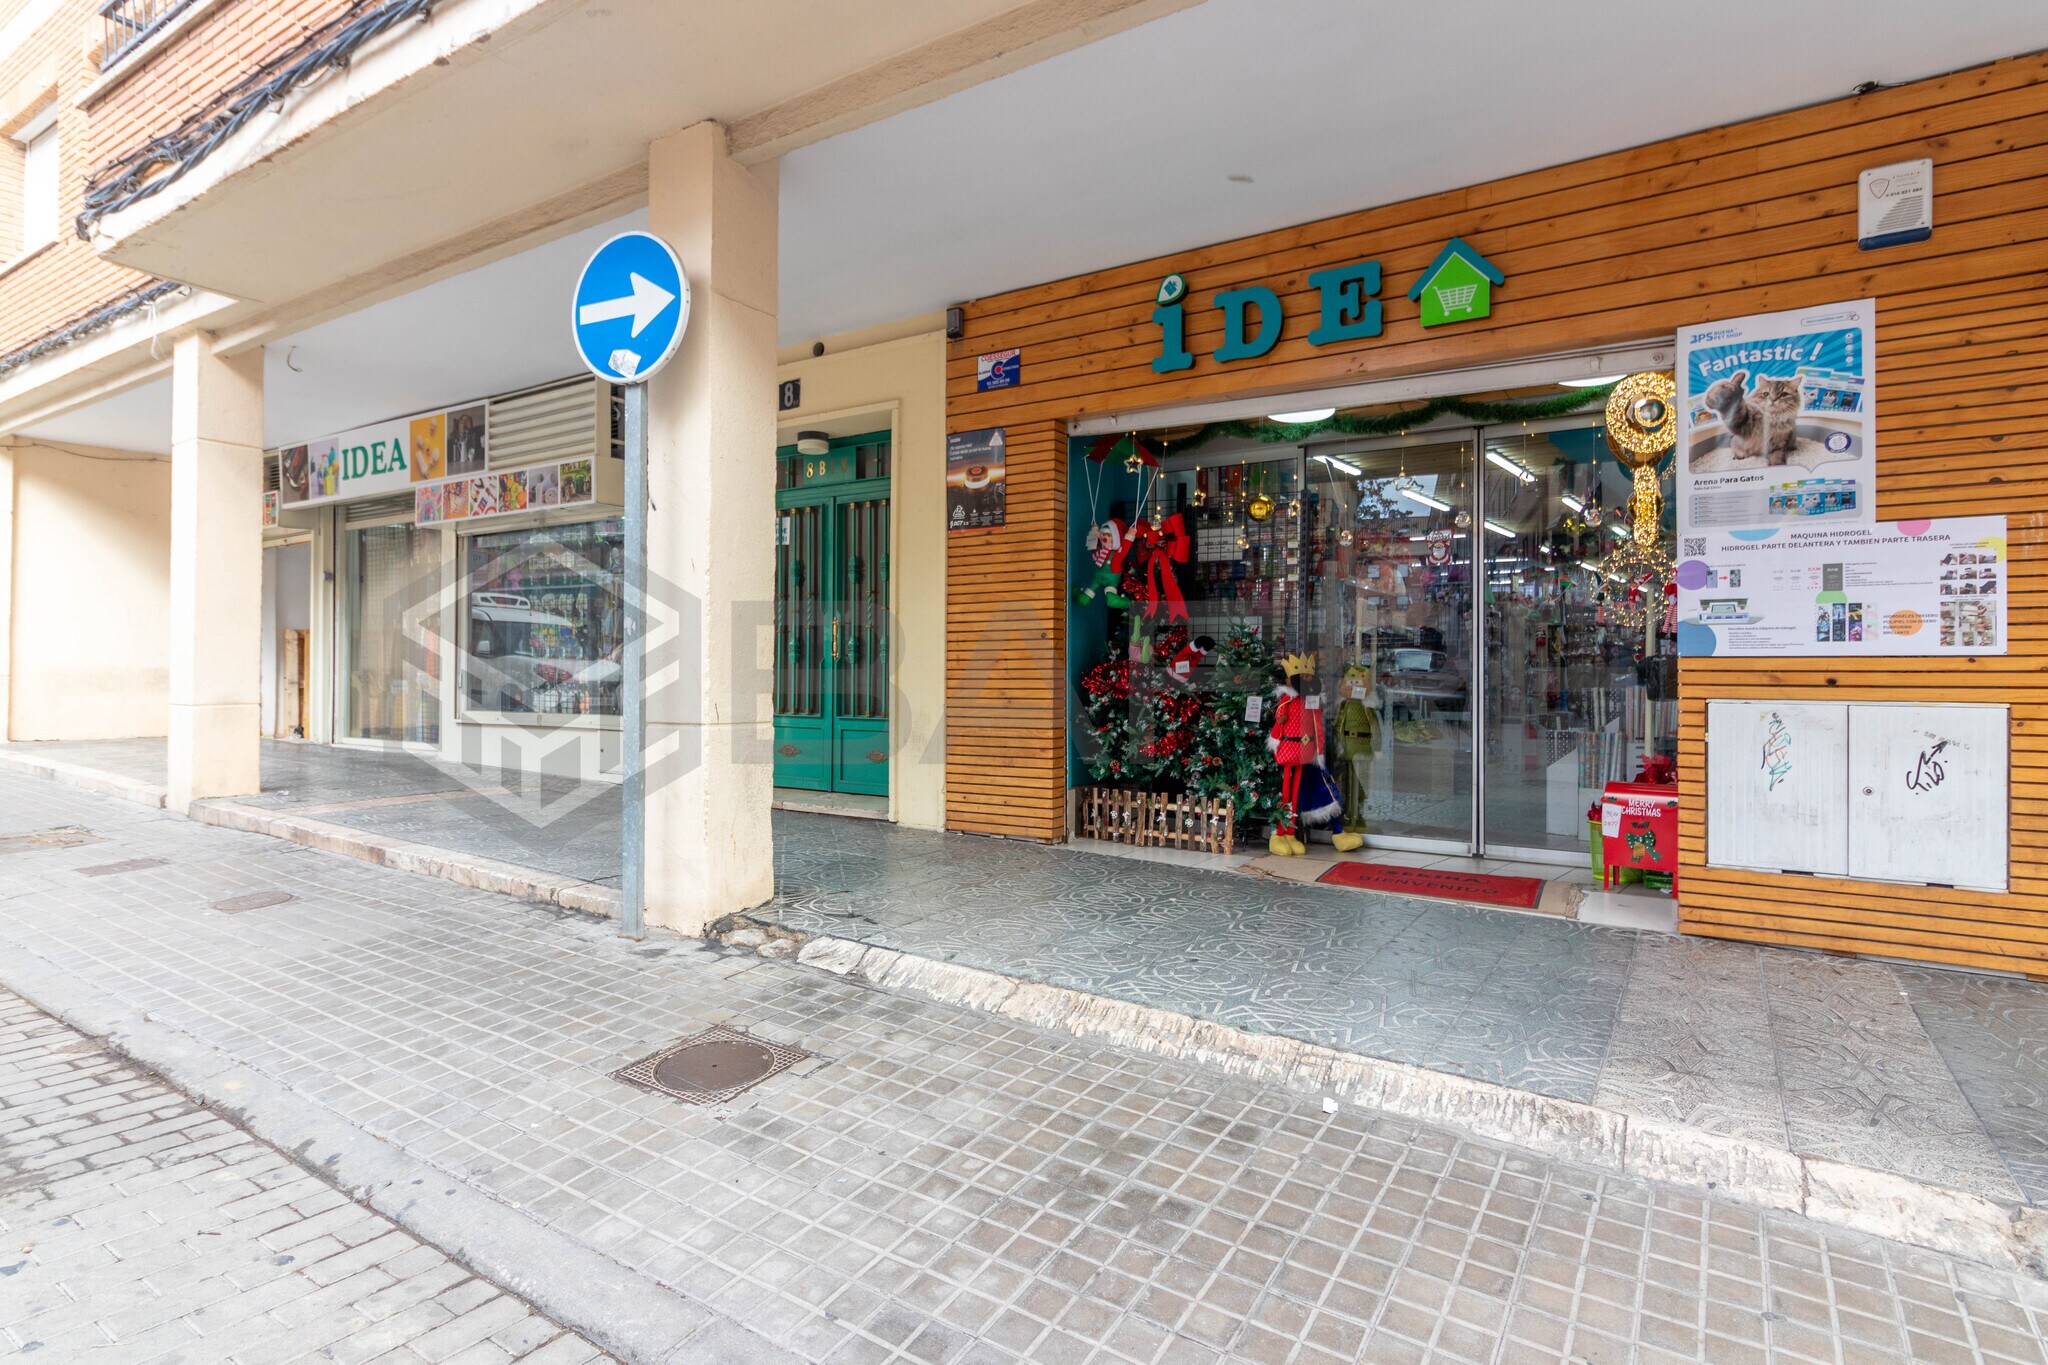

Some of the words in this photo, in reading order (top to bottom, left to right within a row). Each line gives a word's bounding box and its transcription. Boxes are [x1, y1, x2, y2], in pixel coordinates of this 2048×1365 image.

[1698, 343, 1804, 377] Fantastic
[784, 382, 794, 407] 8
[341, 437, 407, 481] IDEA
[806, 462, 814, 478] 8
[1694, 478, 1718, 487] Arena
[1719, 476, 1739, 484] Para
[1739, 474, 1765, 482] Gatos
[1788, 540, 1834, 549] DELANTERA
[1843, 538, 1880, 546] TAMBIEN
[1912, 534, 1951, 542] TRASERA
[1790, 532, 1828, 540] MAQUINA
[1830, 529, 1872, 537] HIDROGEL
[1628, 798, 1655, 808] MERRY
[1621, 806, 1661, 818] CHRISTMAS
[1358, 875, 1499, 895] BIENVENIDO
